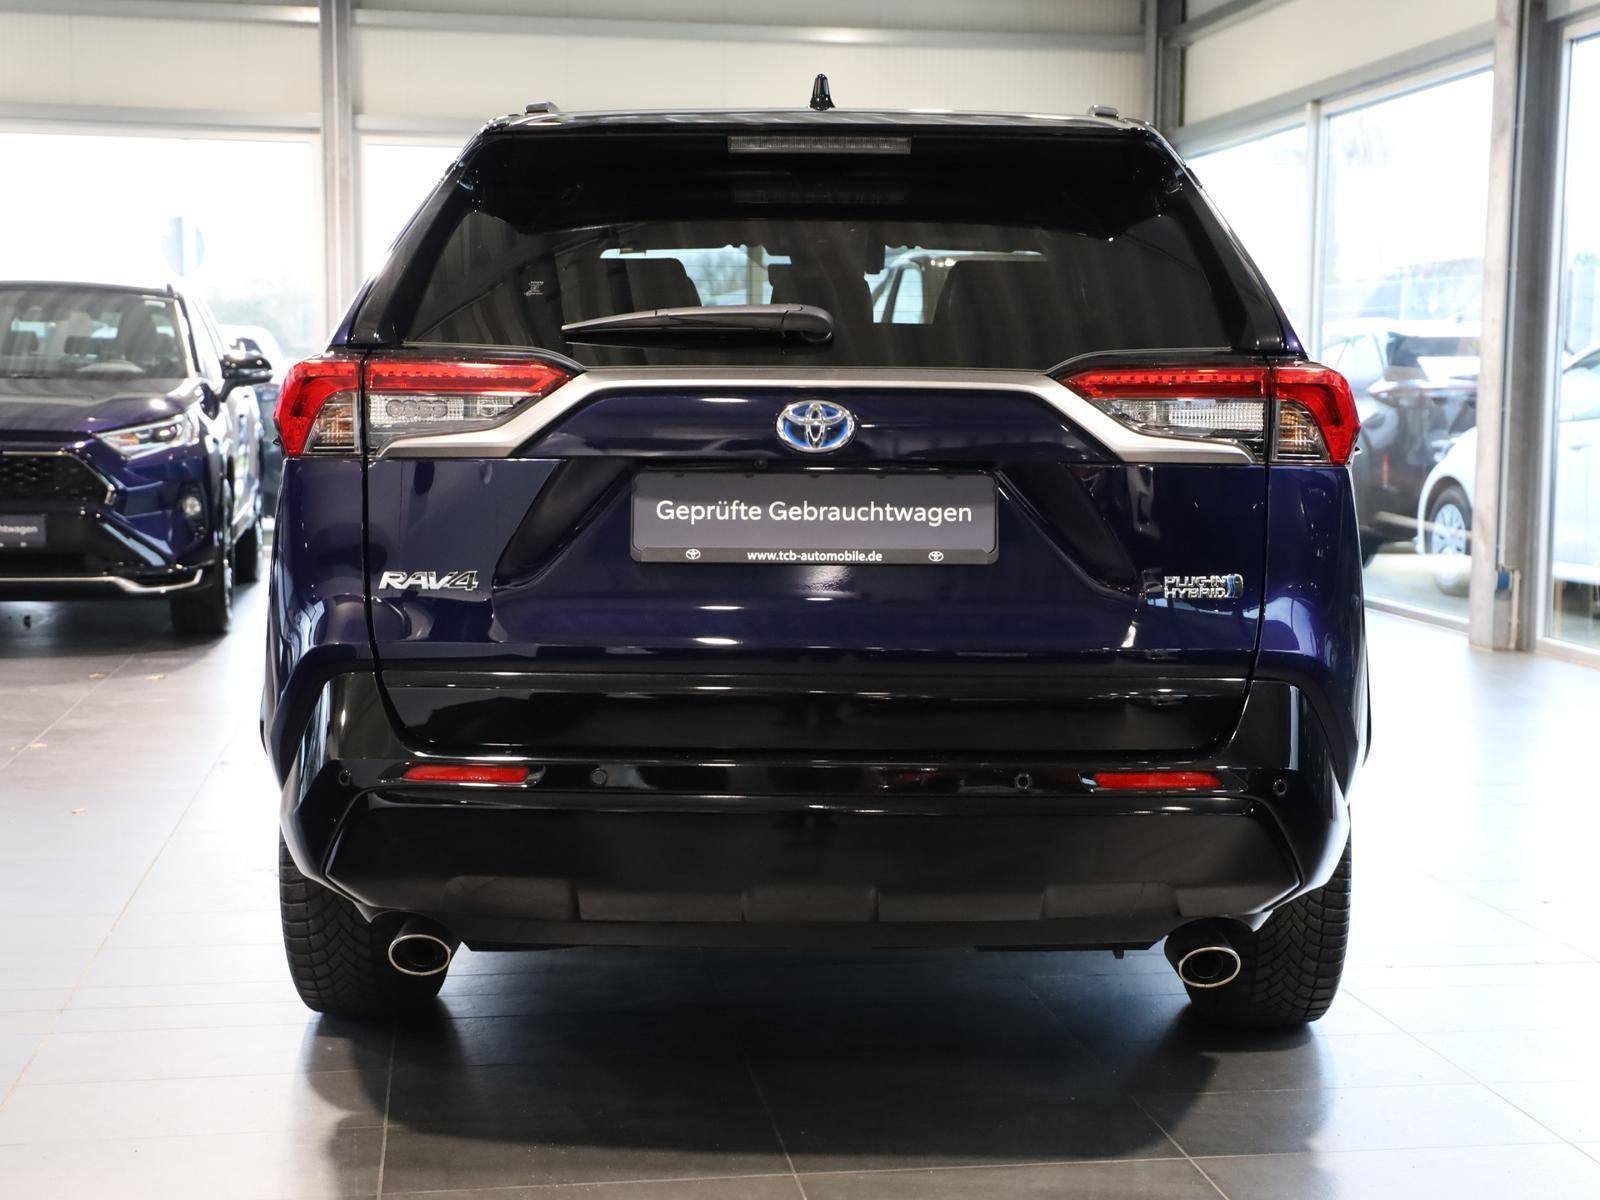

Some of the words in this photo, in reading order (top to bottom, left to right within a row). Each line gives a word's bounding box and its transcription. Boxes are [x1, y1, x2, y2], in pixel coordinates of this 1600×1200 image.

[656, 499, 762, 525] Geprüfte
[768, 500, 973, 527] Gebrauchtwagen
[747, 549, 883, 563] www.tcb-automobile.de
[378, 570, 479, 591] RAV4
[1163, 575, 1229, 588] PLUG-IN
[1163, 586, 1228, 599] HYBRID
